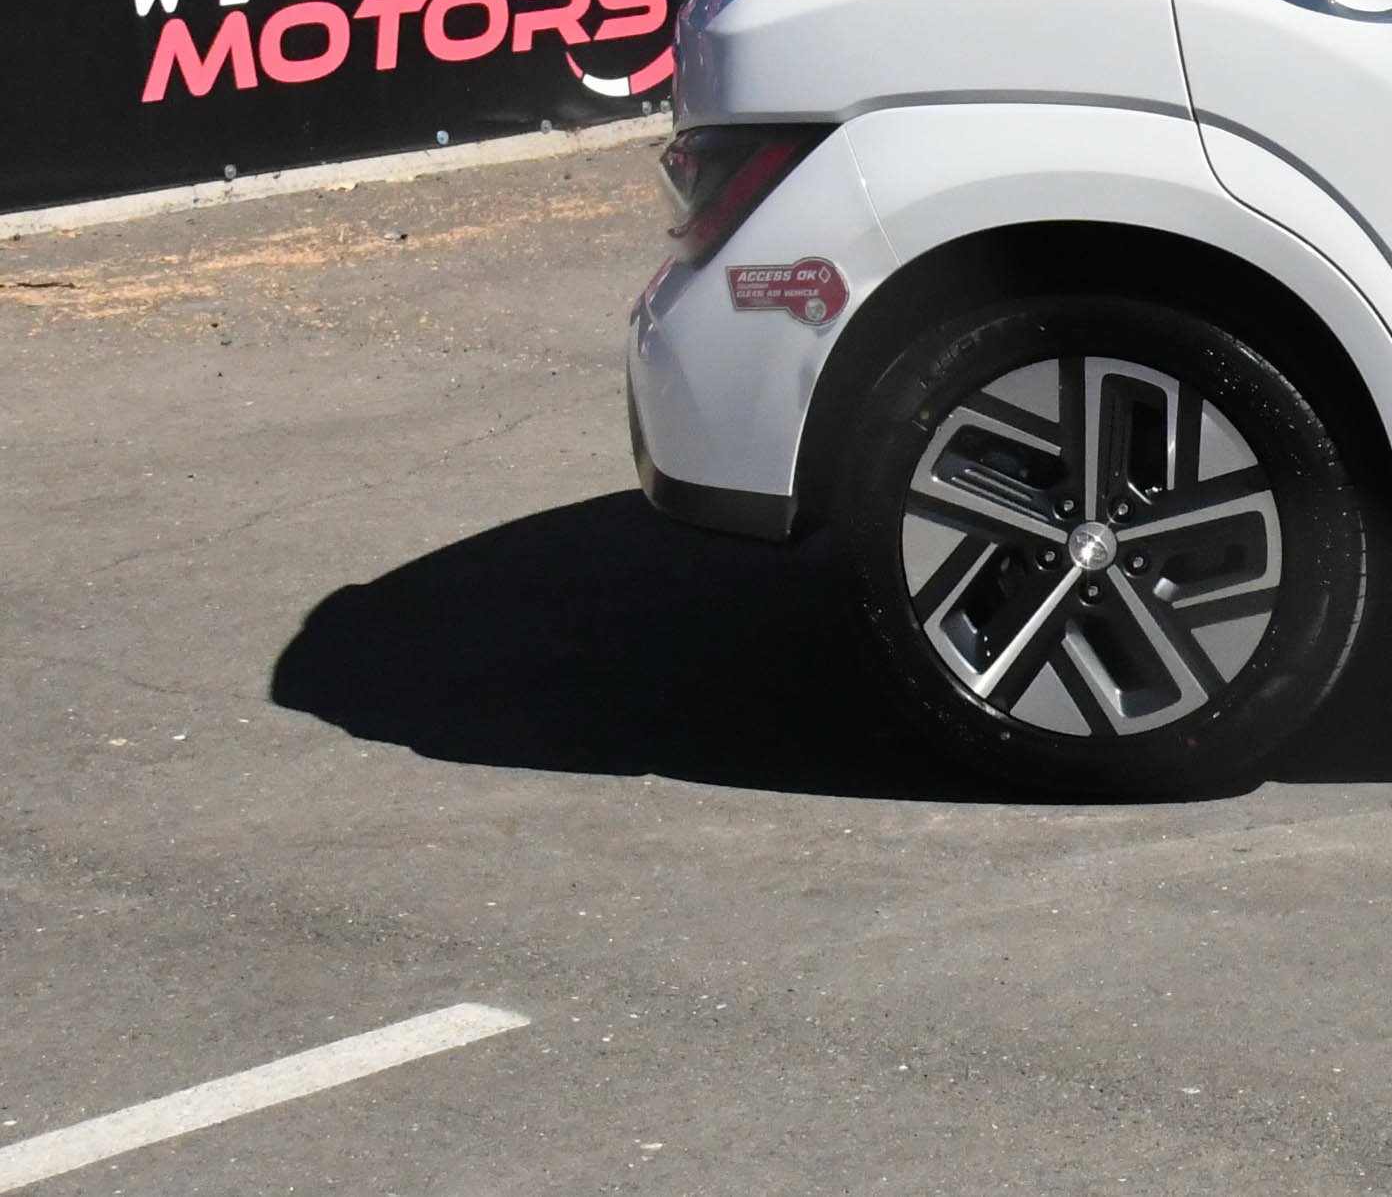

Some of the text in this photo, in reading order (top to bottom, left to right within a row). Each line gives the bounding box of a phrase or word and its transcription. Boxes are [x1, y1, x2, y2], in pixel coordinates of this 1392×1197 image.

[737, 269, 818, 282] ACCESS OK
[784, 288, 820, 297] VEHICLE
